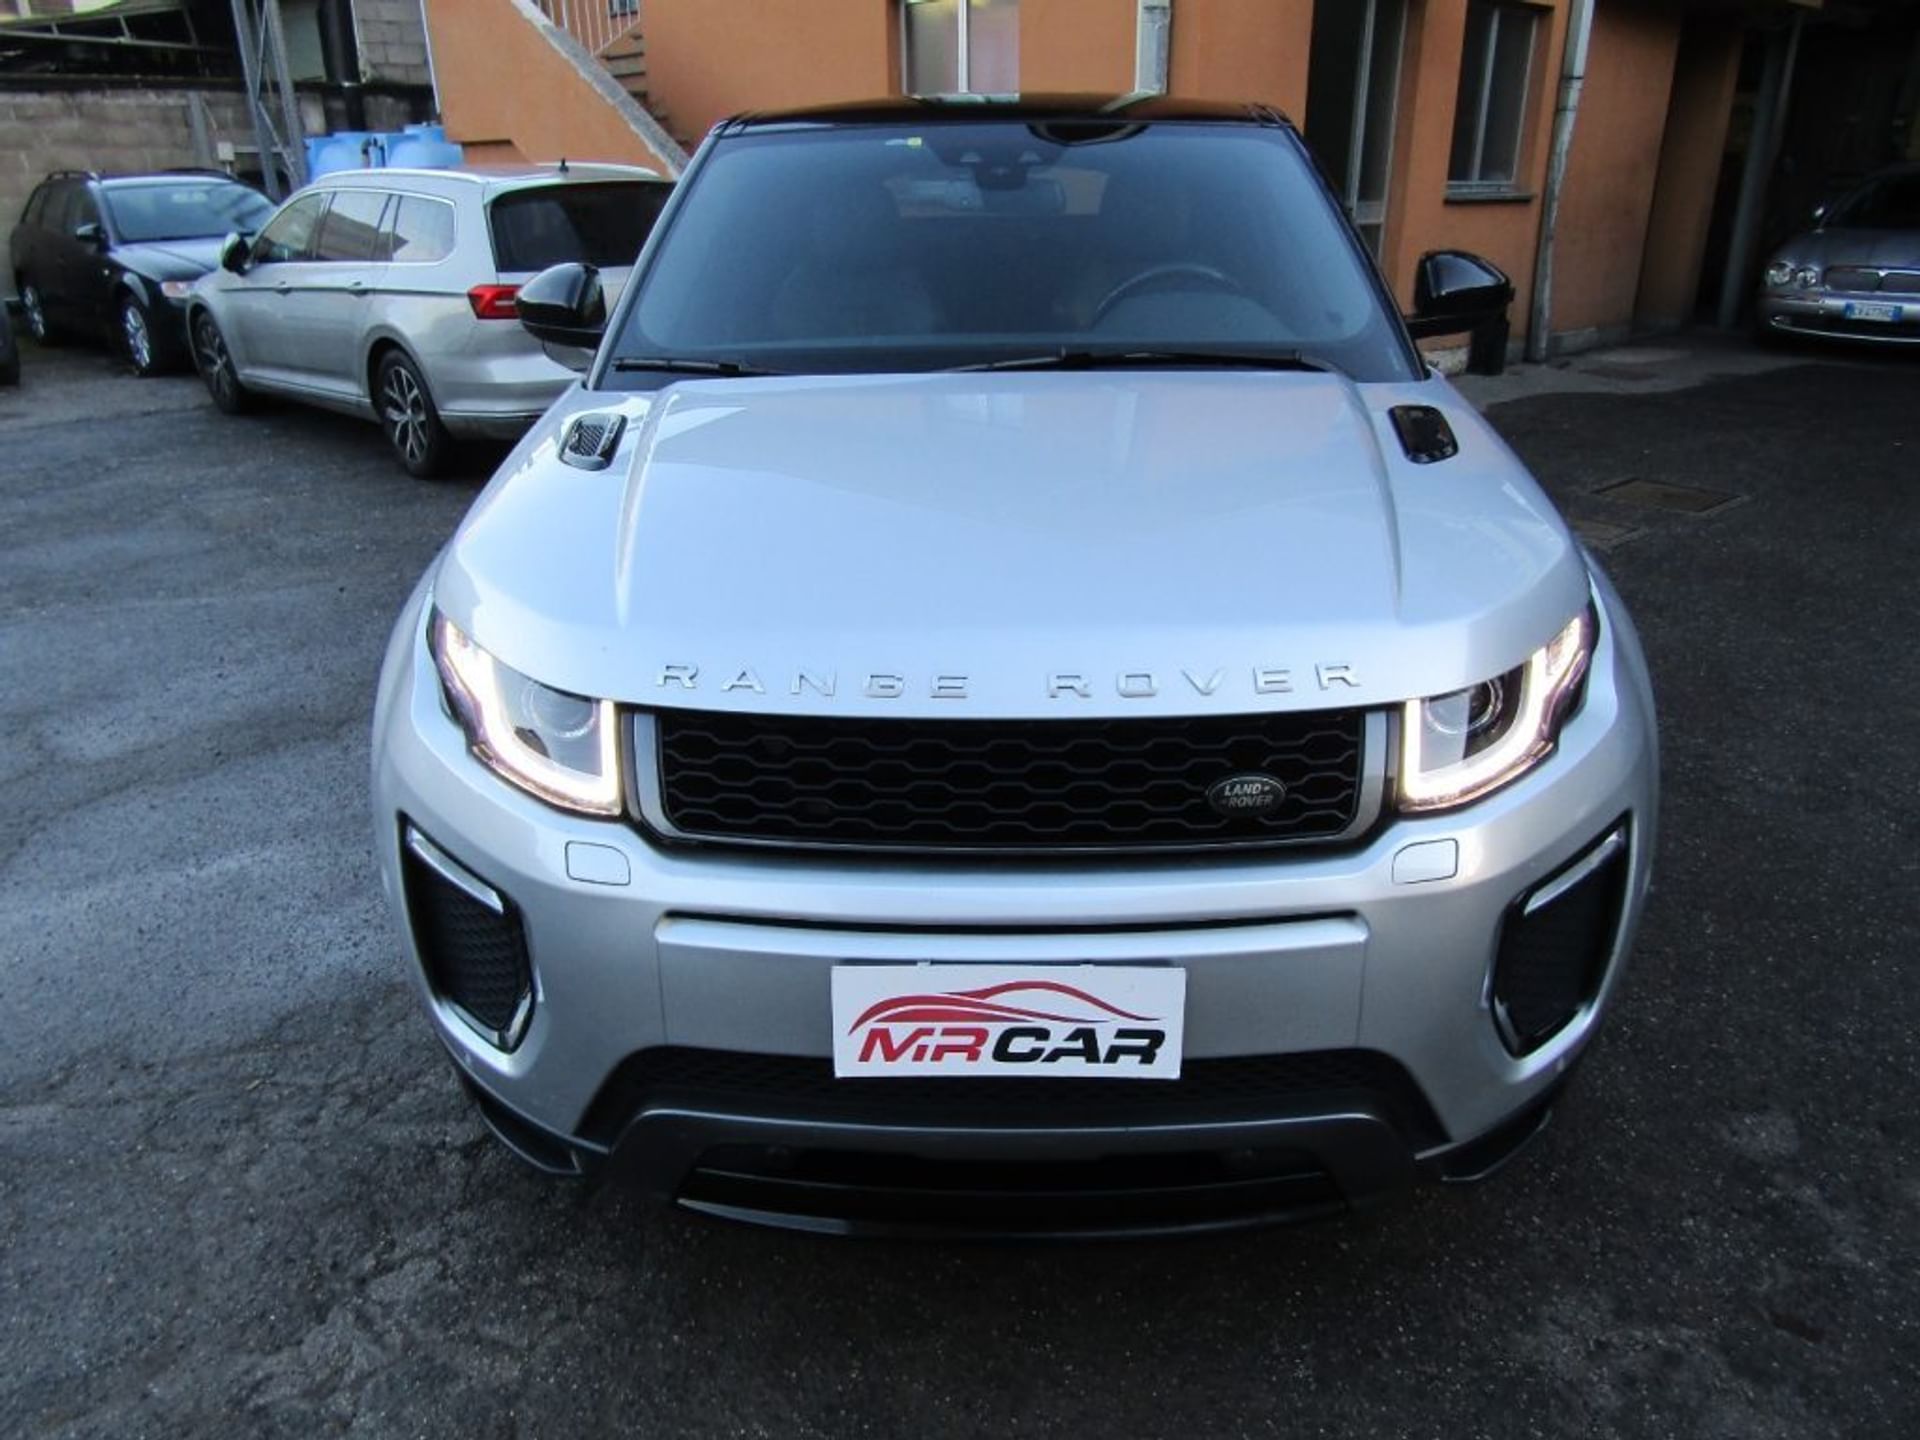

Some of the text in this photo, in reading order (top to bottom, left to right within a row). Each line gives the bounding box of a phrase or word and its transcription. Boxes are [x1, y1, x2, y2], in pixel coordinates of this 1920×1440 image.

[656, 662, 1361, 699] RANGE ROVER
[1224, 783, 1262, 796] LAND
[1228, 795, 1273, 808] ROVER
